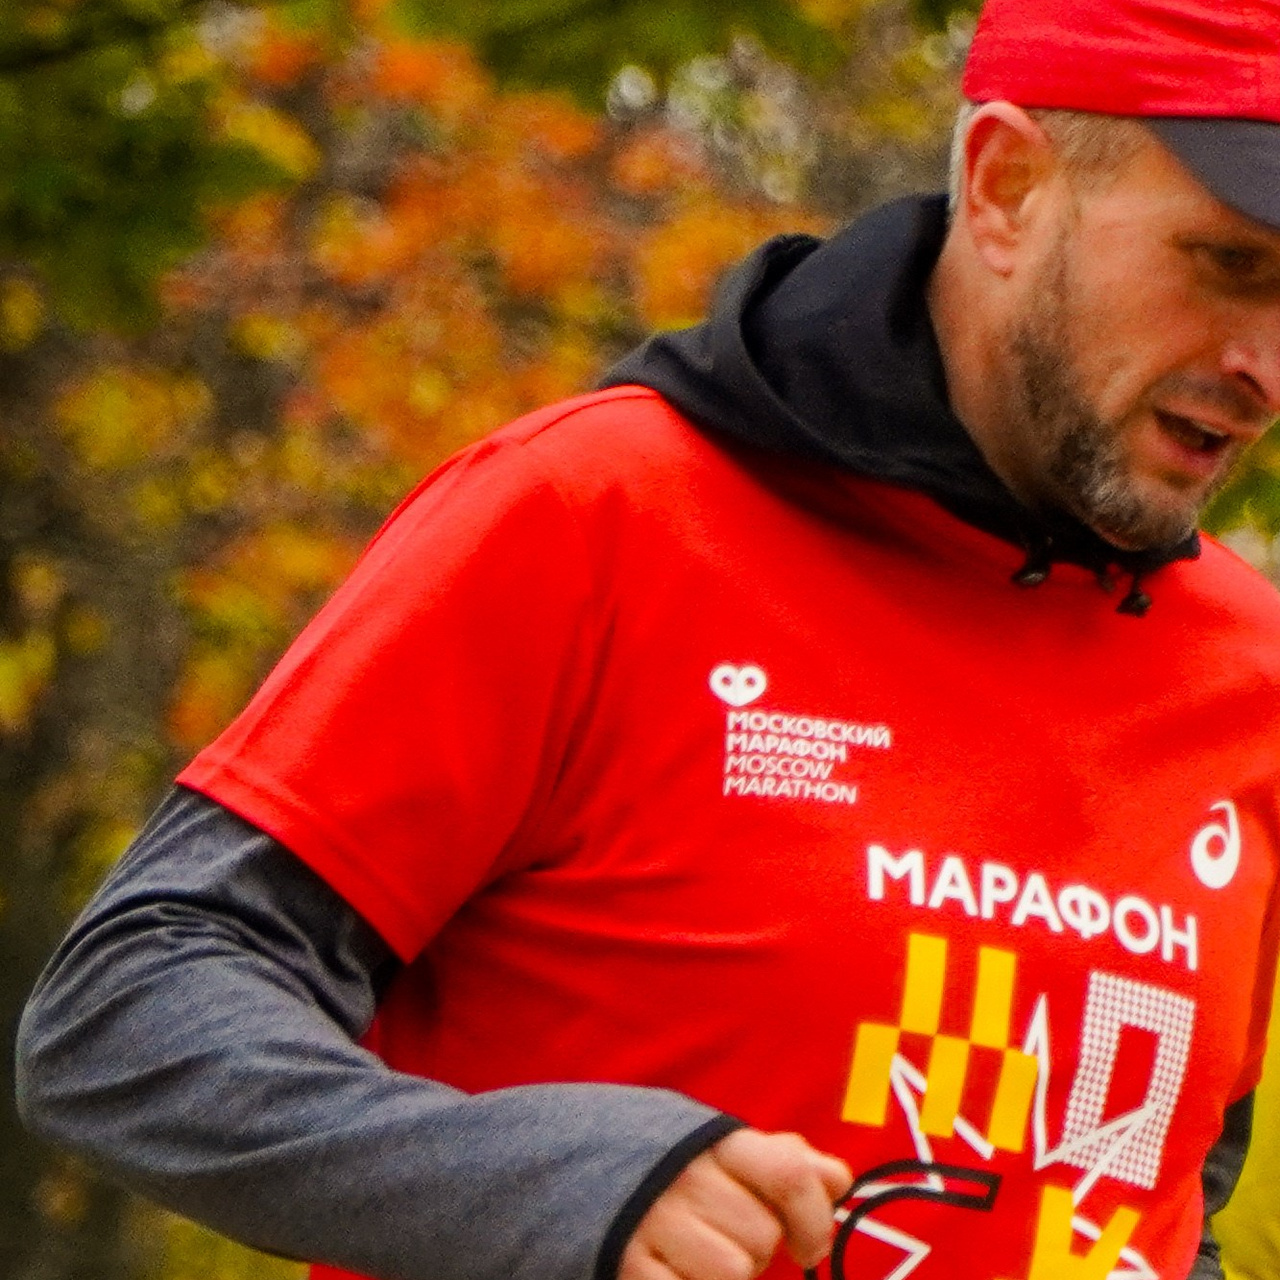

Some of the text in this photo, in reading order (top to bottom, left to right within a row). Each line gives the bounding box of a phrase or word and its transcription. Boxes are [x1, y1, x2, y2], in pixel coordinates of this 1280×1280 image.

[727, 711, 891, 748] МОСКОВСКИЙ
[726, 733, 847, 763] МАРАФОН
[725, 754, 834, 780] MOSCOW
[723, 776, 858, 805] MARATHON
[866, 844, 1198, 970] МАРАФОН
